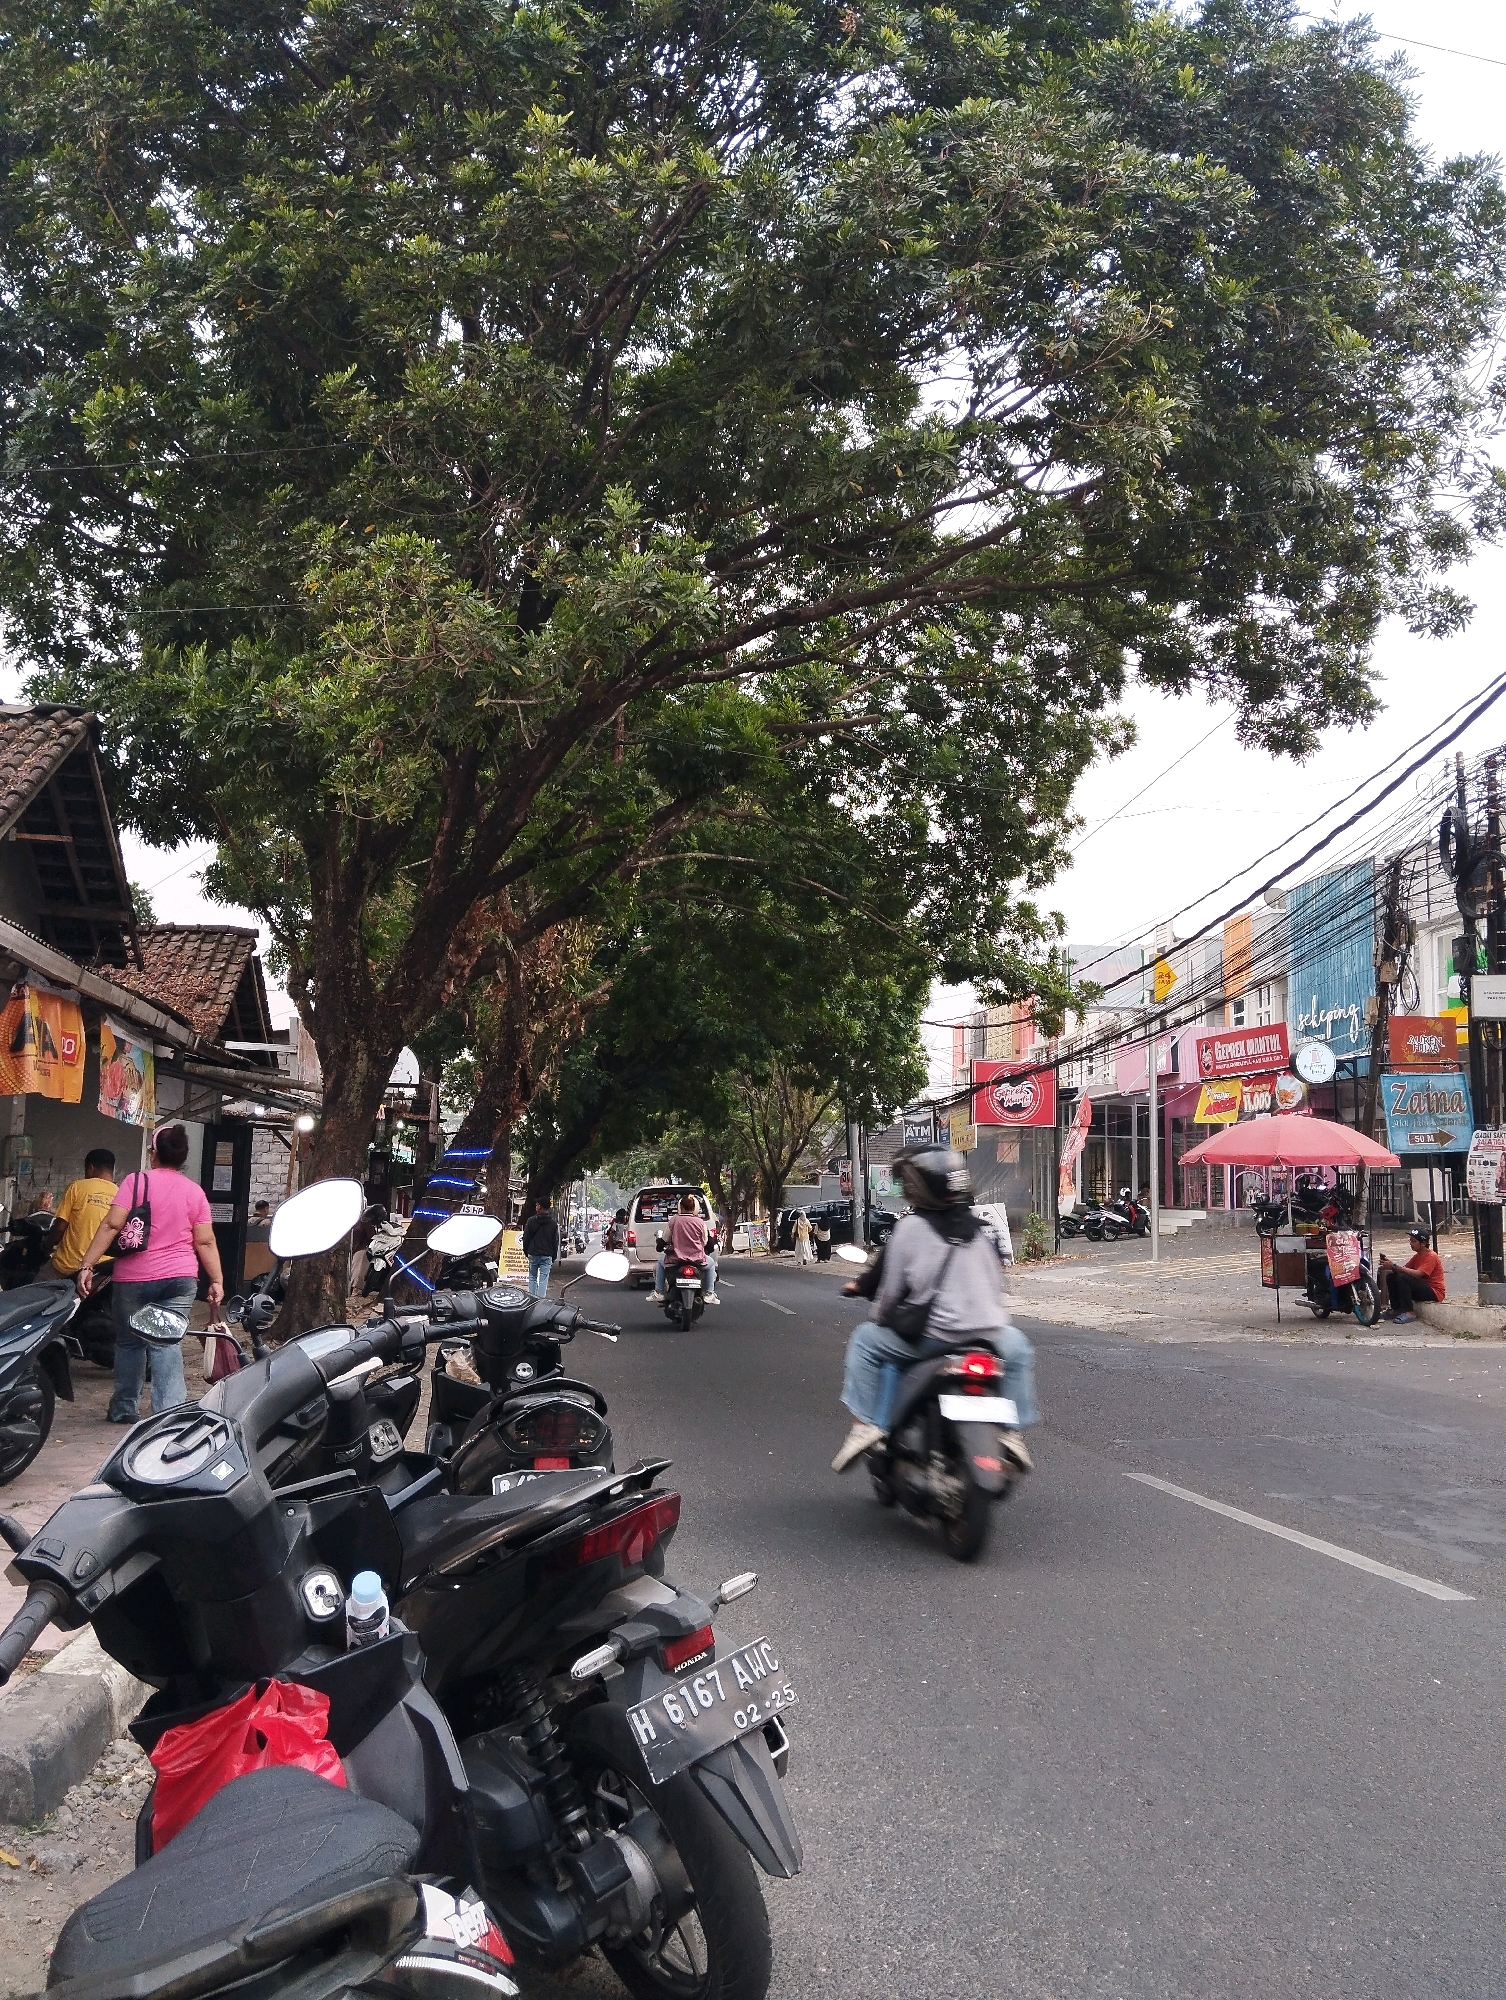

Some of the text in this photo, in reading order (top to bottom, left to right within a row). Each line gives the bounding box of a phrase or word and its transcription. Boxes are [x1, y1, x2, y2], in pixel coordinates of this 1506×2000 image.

[1157, 971, 1171, 980] 24
[1299, 995, 1360, 1043] sekeping
[1215, 1034, 1282, 1060] GEPREK MANTUL
[905, 1125, 931, 1138] ATM
[1414, 1135, 1425, 1143] 50
[472, 1207, 484, 1215] HP
[674, 1651, 708, 1673] HONDA
[631, 1643, 779, 1745] H 6167 AWC
